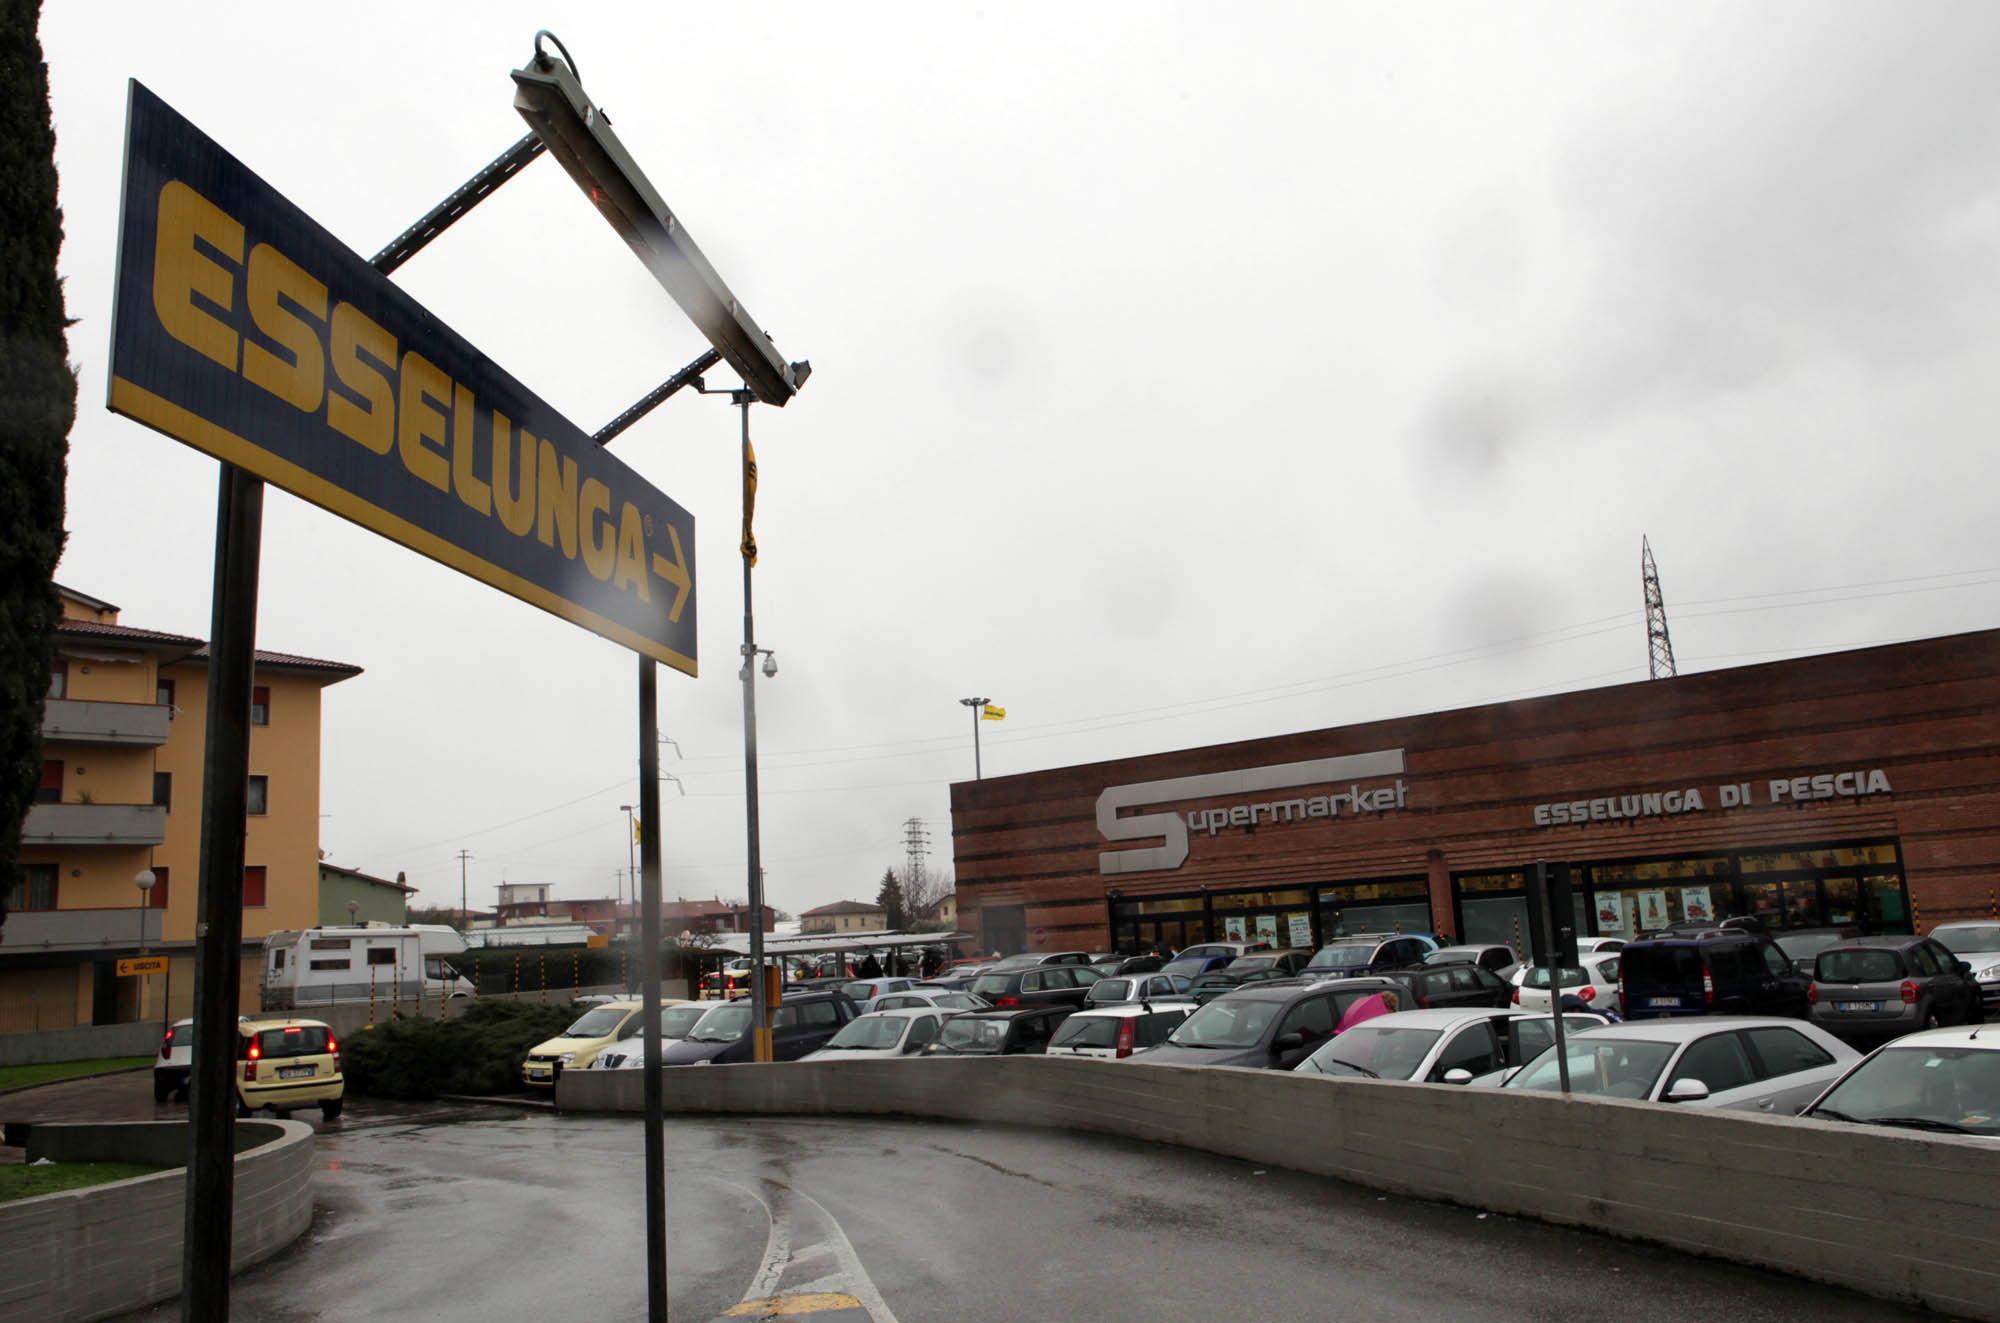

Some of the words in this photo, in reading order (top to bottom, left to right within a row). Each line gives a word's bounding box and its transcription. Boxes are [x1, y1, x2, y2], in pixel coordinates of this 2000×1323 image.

[154, 179, 650, 604] ESSELUNGA
[1096, 748, 1407, 875] Supermarket
[1534, 789, 1704, 827] ESSELUNGA
[1720, 782, 1751, 808] DI
[1770, 769, 1892, 803] PESCIA
[134, 962, 161, 971] USCITA
